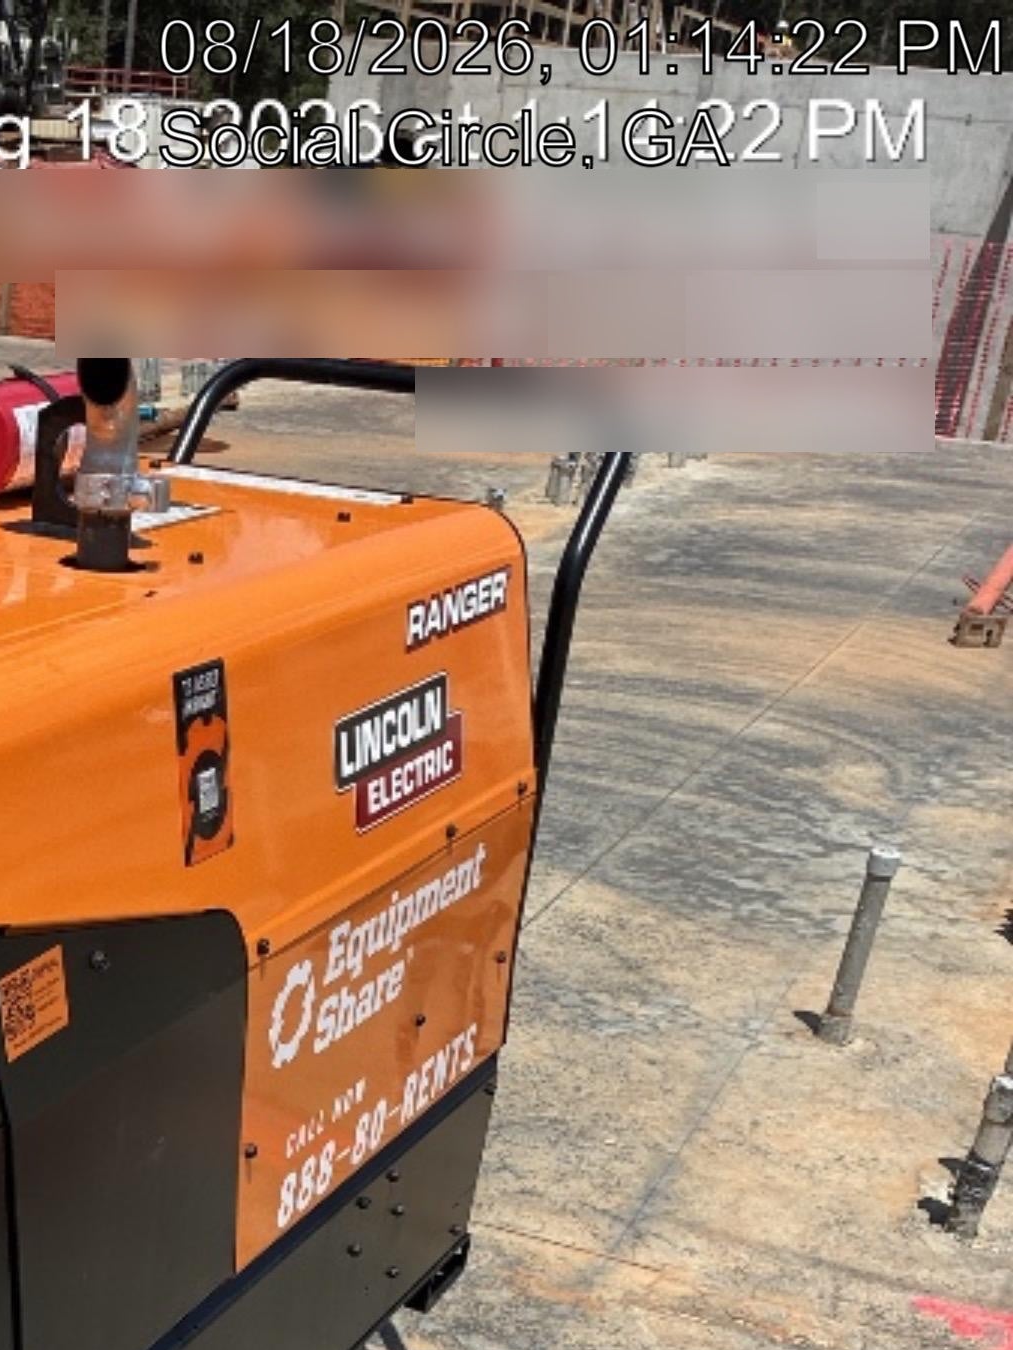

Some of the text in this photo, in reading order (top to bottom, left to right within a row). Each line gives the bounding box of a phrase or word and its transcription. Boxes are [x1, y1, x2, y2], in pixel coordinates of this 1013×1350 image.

[405, 566, 511, 650] RANGER
[339, 686, 442, 779] LINCOLN
[366, 741, 454, 815] ELECTRIC
[322, 841, 487, 987] Equipment
[311, 957, 406, 1054] Share
[276, 1021, 478, 1230] 888-80-RENTS
[285, 1077, 367, 1159] CALL NOW
